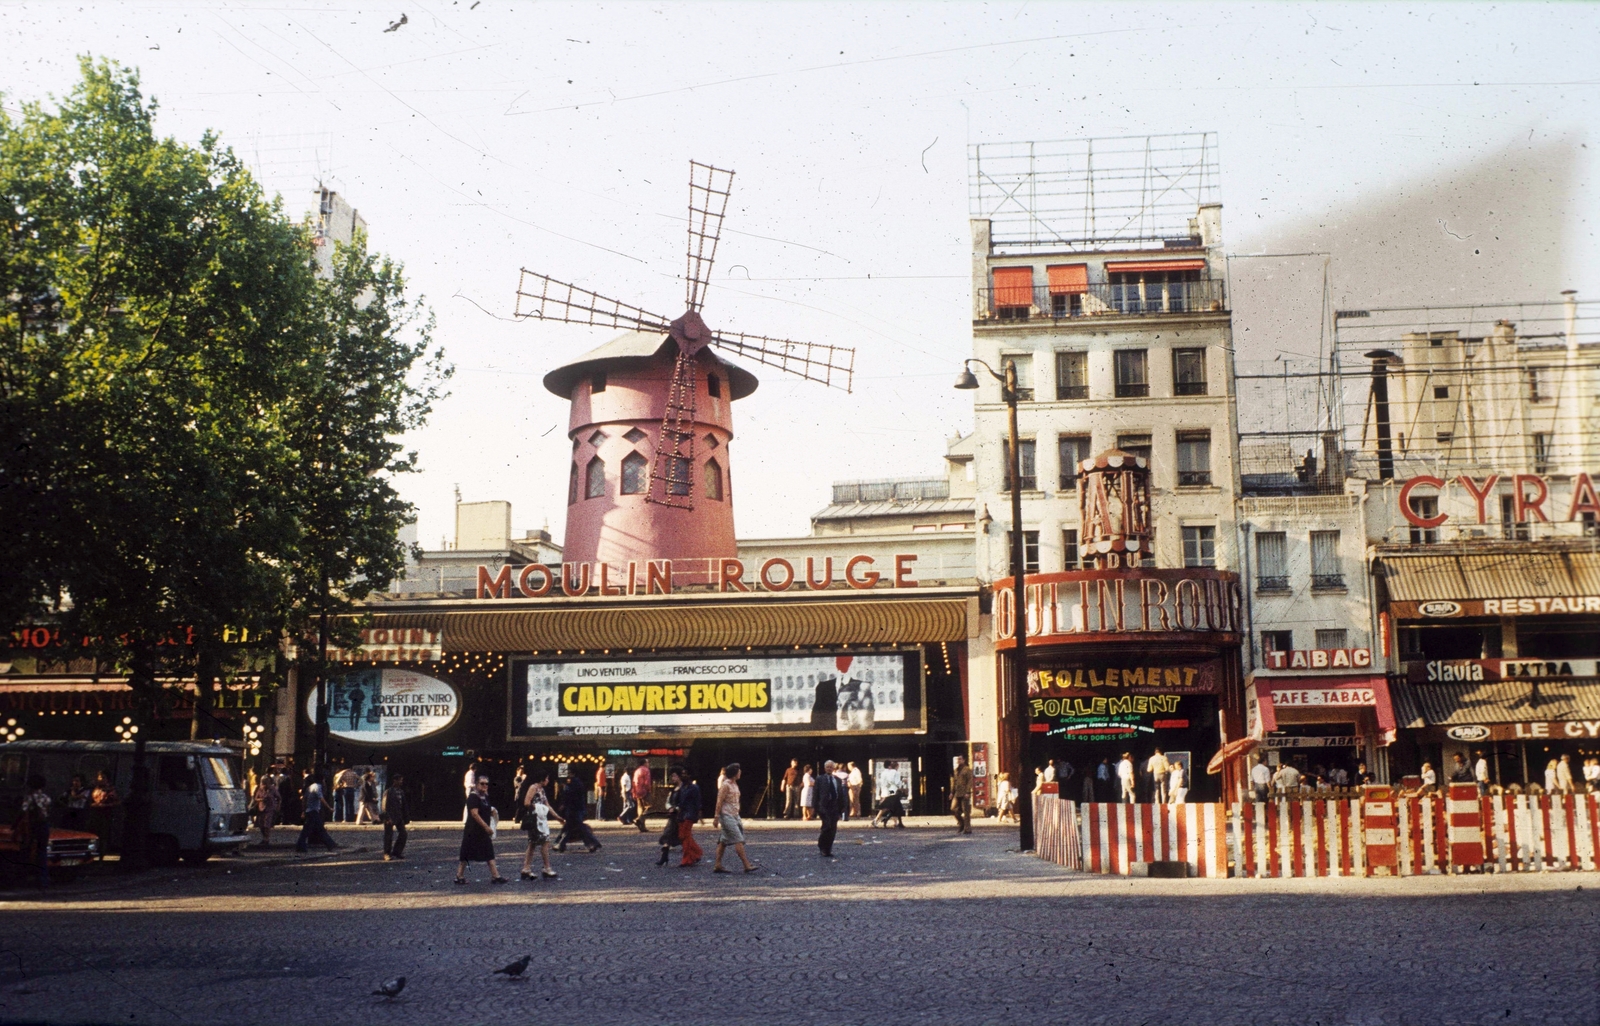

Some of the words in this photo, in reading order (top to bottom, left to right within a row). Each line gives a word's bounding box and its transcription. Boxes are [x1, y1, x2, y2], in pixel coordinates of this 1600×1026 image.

[1399, 472, 1600, 529] CYRA
[1107, 553, 1139, 568] DU
[476, 559, 673, 599] MOULIN
[719, 554, 919, 592] ROUGE
[992, 578, 1125, 640] OULIN
[1484, 597, 1600, 615] RESTAUR
[1270, 650, 1370, 668] TABAC
[577, 668, 599, 677] LINO
[600, 667, 637, 677] VENTURA
[673, 665, 726, 675] FRANCESCO
[728, 664, 748, 674] ROSI
[1039, 667, 1198, 689] FOLLEMENT
[1426, 660, 1484, 681] Slavia
[1506, 662, 1573, 676] EXTRA
[412, 694, 424, 703] DE
[428, 693, 452, 702] NIRO
[563, 685, 687, 712] CADAVRES
[690, 682, 768, 712] EXQUIS
[1029, 695, 1180, 717] FOLLEMENT
[1322, 691, 1371, 703] TABAC
[403, 704, 449, 716] DRIVER
[574, 727, 612, 735] CADAVRES
[613, 726, 639, 734] EXQUIS
[1515, 722, 1549, 738] LE
[1564, 721, 1600, 737] CY
[1268, 738, 1300, 747] CAFE
[1324, 736, 1362, 746] TABAC
